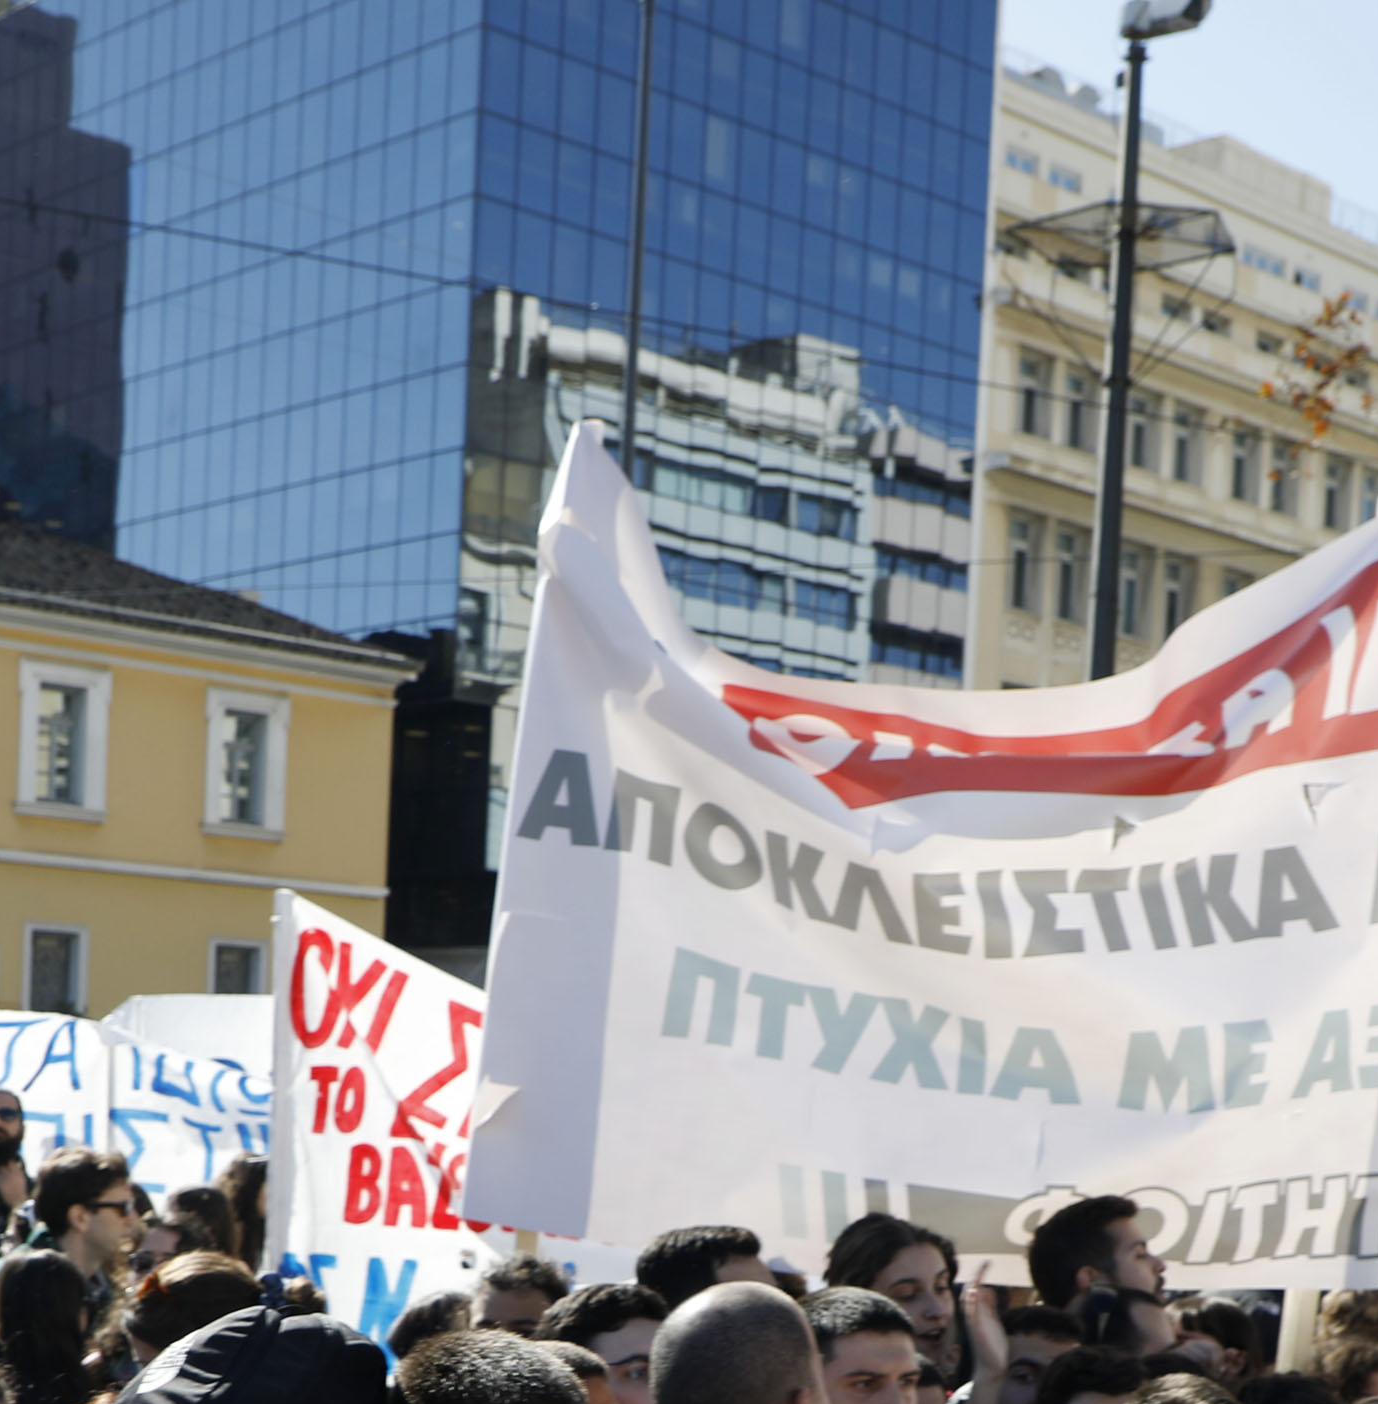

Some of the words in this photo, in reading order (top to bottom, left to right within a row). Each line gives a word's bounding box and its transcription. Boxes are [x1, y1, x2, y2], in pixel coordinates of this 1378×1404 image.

[517, 747, 1340, 959] ΑΠΟΚΛΕΙΣΤΙΚΑ
[290, 928, 410, 1056] ΟΧΙ
[661, 947, 1082, 1105] ΠΤΥΧΙΑ
[1118, 1017, 1272, 1113] ΜΕ
[310, 1066, 366, 1134] ΤΟ
